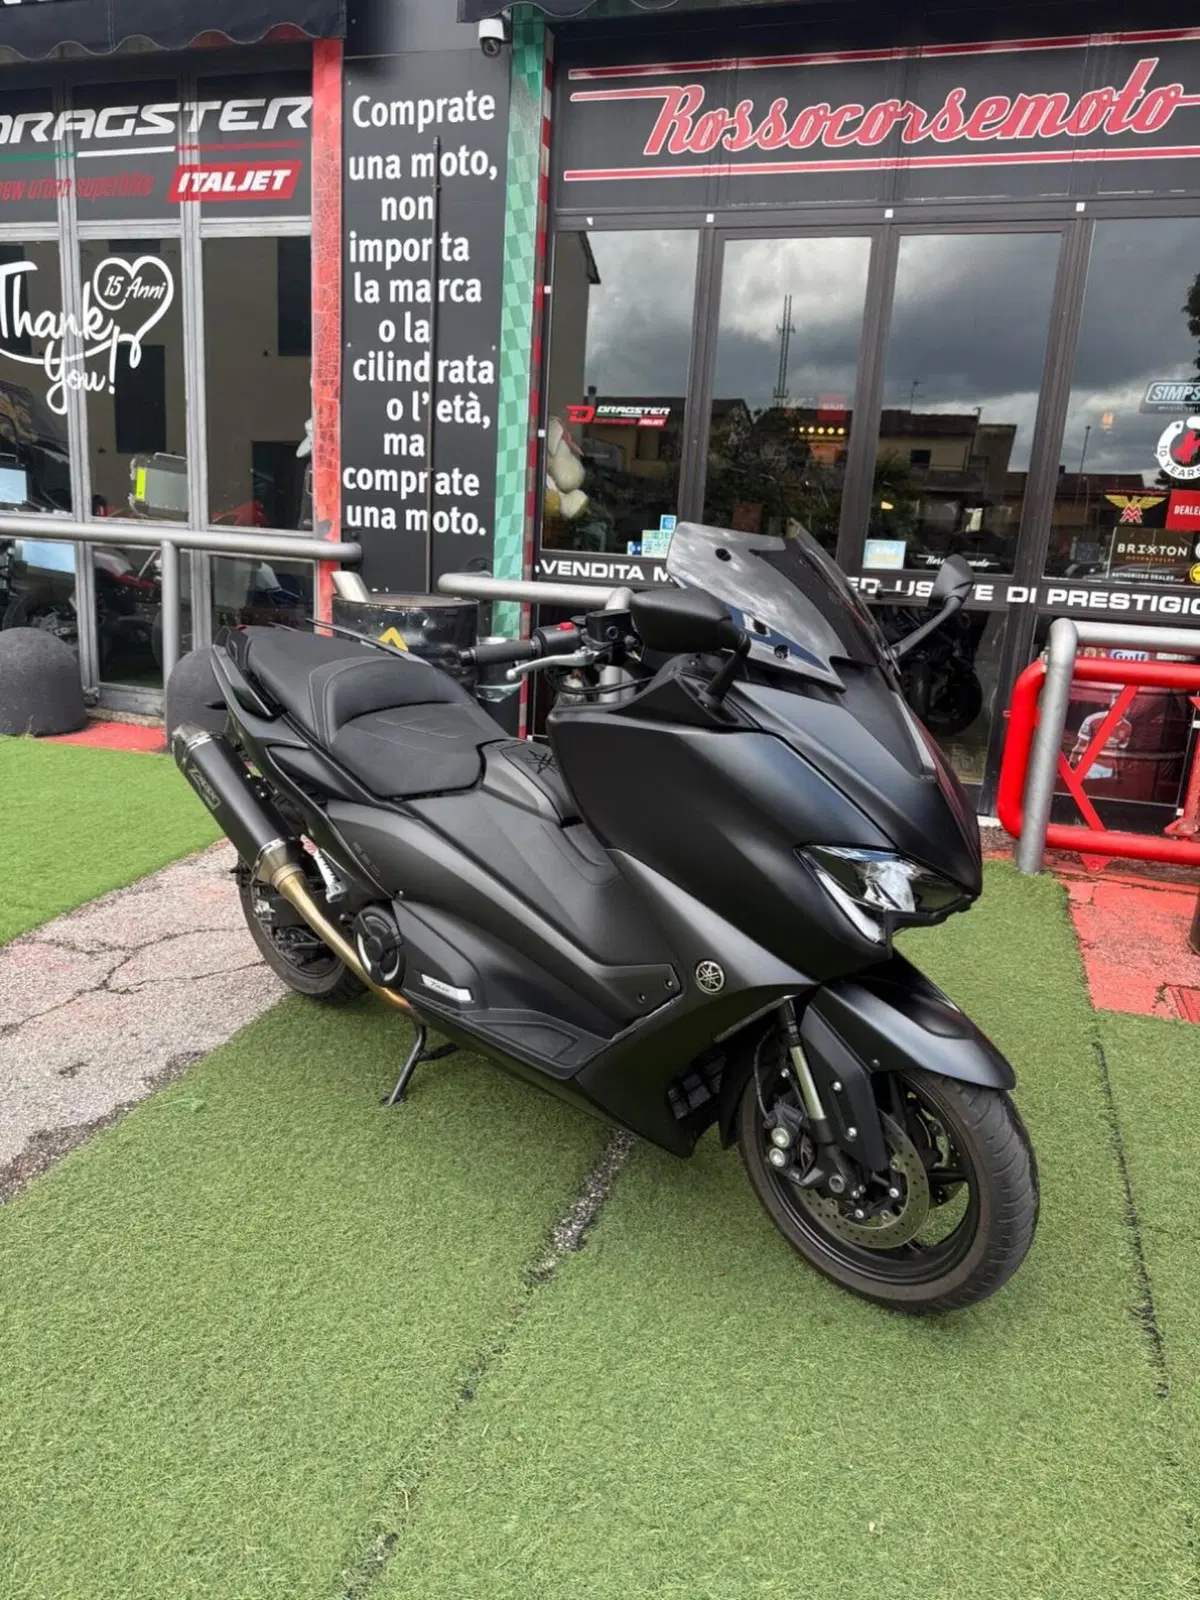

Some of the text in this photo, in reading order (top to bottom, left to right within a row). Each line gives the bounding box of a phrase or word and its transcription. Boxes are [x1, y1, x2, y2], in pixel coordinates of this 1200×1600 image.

[352, 89, 496, 134] Comprate
[643, 57, 1188, 156] Rossocorsemoto
[349, 144, 499, 181] una moto,
[177, 168, 292, 193] ITALJET
[381, 195, 434, 222] non
[349, 230, 470, 271] importa
[104, 275, 167, 300] 15 Anni
[354, 271, 482, 304] la marca
[378, 311, 431, 343] o la
[353, 350, 495, 384] cilindrata
[386, 398, 404, 421] o
[597, 405, 671, 415] DRAGSTER
[383, 432, 426, 457] ma
[342, 466, 480, 500] comprate
[346, 504, 487, 536] una moto.
[1117, 543, 1188, 557] BRIXTON
[540, 559, 645, 581] VENDITA
[1007, 585, 1037, 604] DI
